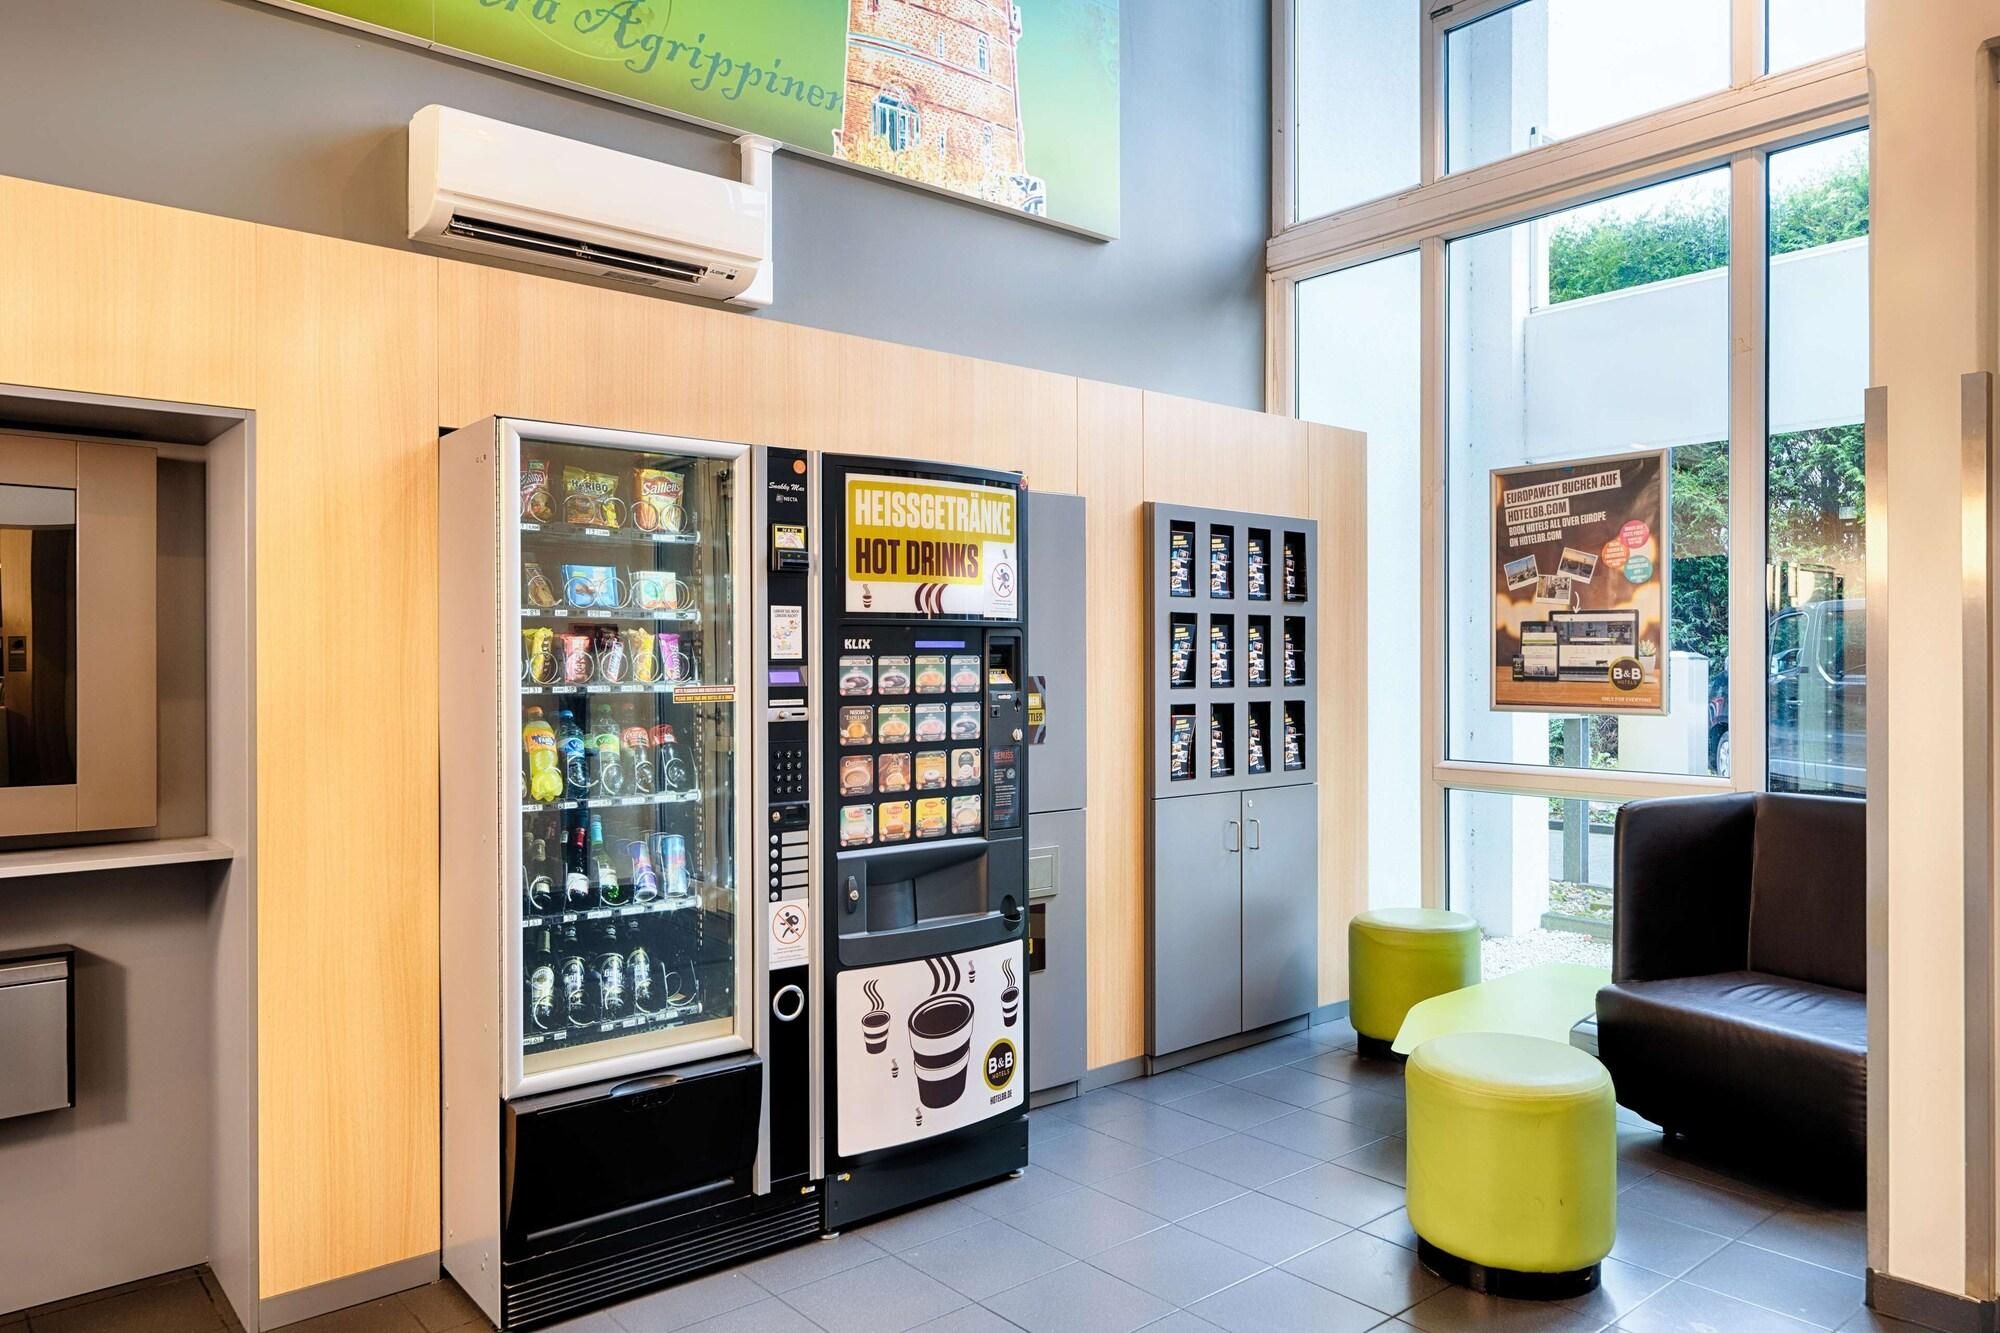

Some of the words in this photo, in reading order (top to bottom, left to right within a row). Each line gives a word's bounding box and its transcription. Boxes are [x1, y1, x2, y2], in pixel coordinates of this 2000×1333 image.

[1506, 484, 1560, 505] EUROPAWEIT
[1562, 476, 1598, 491] BUCHEN
[1600, 473, 1618, 487] AUF
[855, 488, 1011, 536] HEISSGETRÄNKE
[1508, 501, 1567, 522] HOTELBB.COM
[1509, 525, 1526, 536] BOOK
[1526, 521, 1549, 533] HOTELS
[1549, 518, 1561, 530] ALL
[1562, 515, 1579, 527] OVER
[1580, 511, 1606, 524] EUROPE
[1509, 537, 1519, 547] ON
[856, 538, 900, 575] HOT
[906, 540, 979, 578] DRINKS
[844, 639, 871, 650] KLIX
[1613, 667, 1641, 680] B&B
[989, 1052, 1013, 1074] B&B
[991, 1069, 1010, 1080] HOTELS
